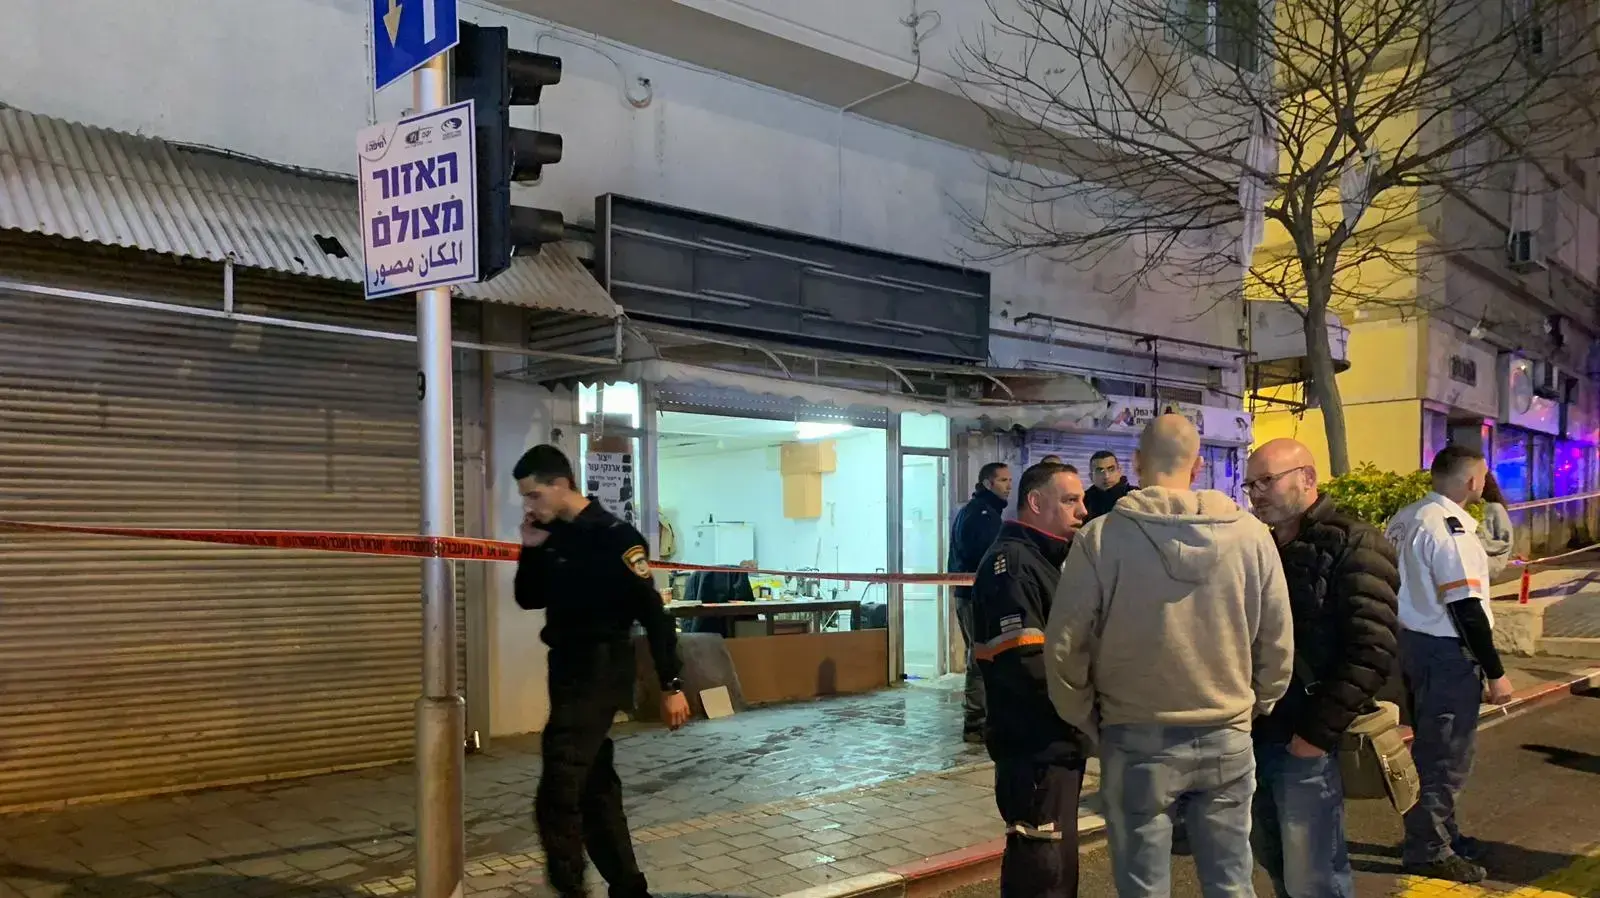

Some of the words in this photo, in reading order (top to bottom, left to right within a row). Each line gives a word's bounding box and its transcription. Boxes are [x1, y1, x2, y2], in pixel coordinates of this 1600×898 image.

[372, 151, 459, 200] האזור
[371, 198, 464, 248] מצולם
[372, 256, 414, 287] مصور
[418, 239, 463, 278] المكان
